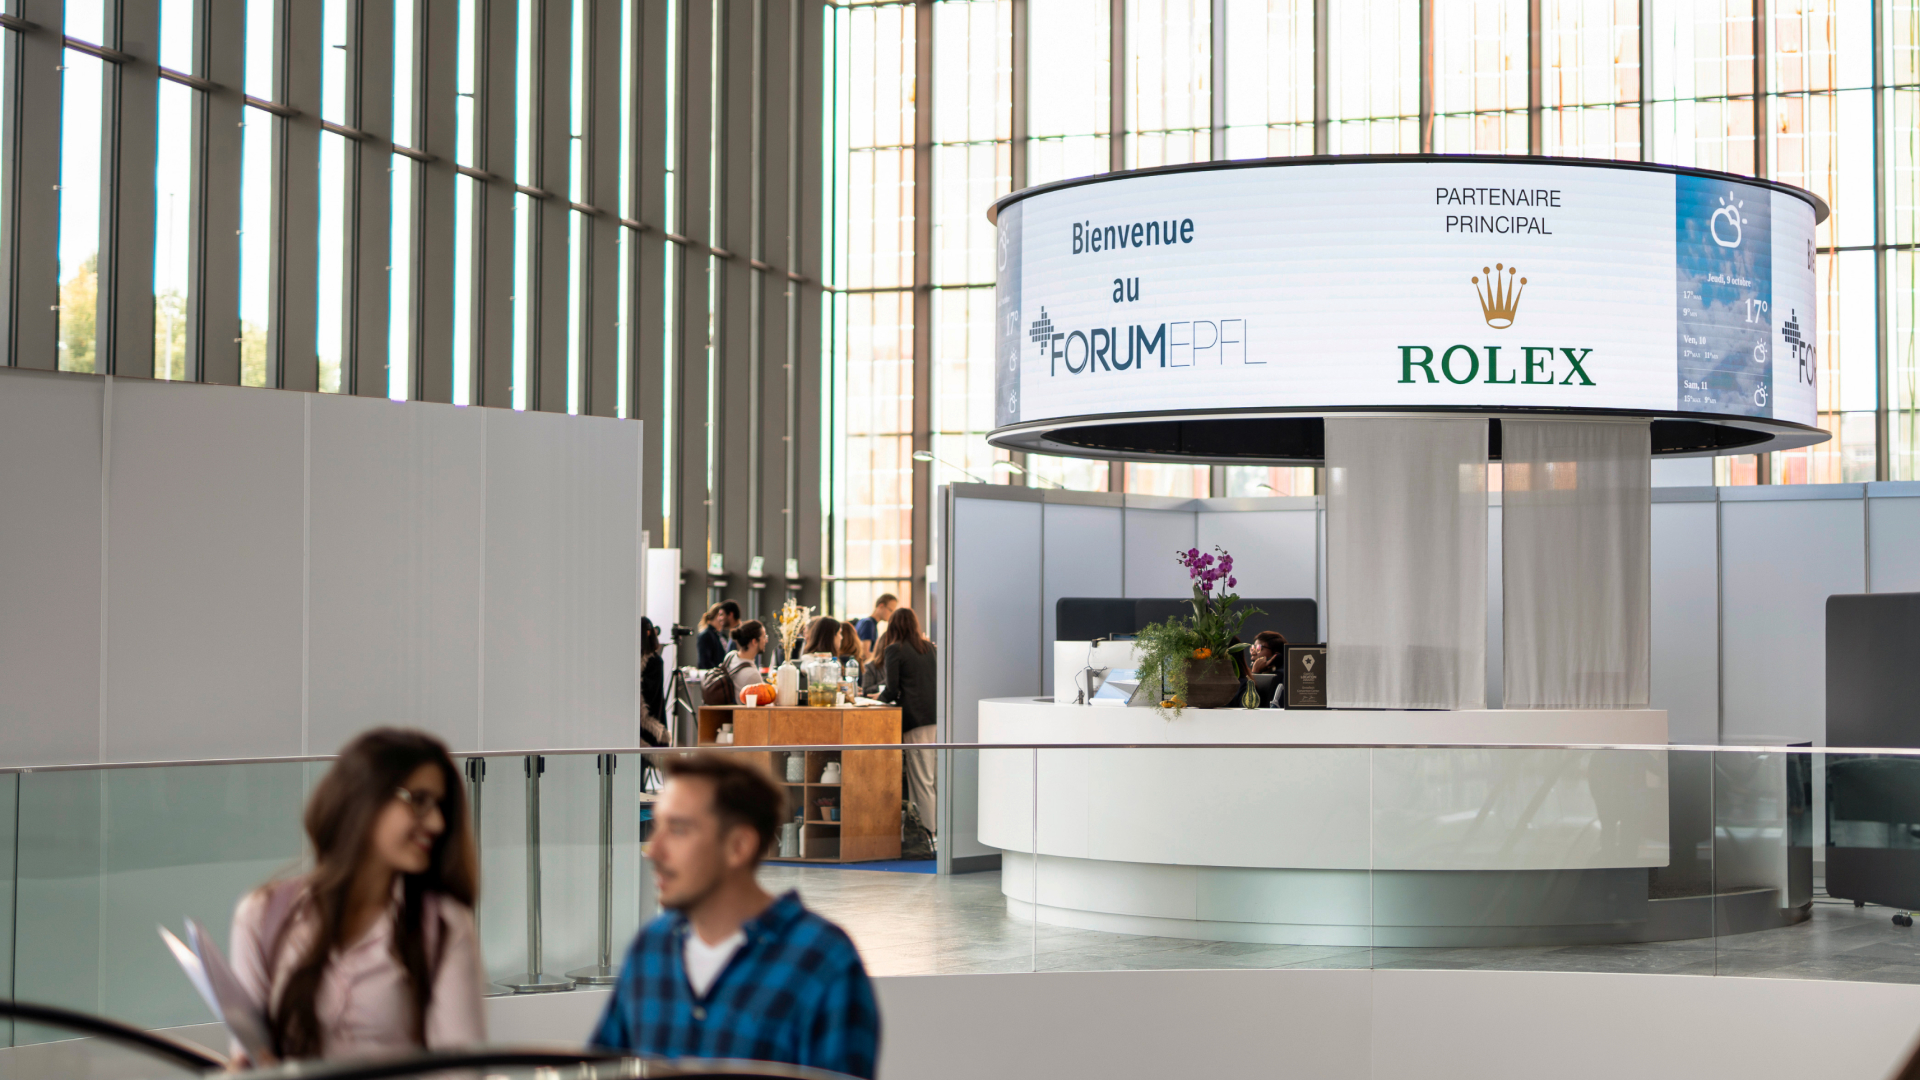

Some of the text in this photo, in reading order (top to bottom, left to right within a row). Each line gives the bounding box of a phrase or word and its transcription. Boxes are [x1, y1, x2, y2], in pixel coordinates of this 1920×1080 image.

[1436, 187, 1561, 207] PARTENAIRE
[1446, 215, 1552, 235] PRINCIPAL
[1072, 218, 1194, 255] Bienvenue
[1112, 277, 1140, 303] au
[1707, 273, 1752, 287] Jeudi, 9 octobre
[1744, 298, 1768, 324] 17°
[1683, 334, 1707, 345] Ven, 10
[1397, 344, 1597, 386] ROLEX
[1683, 380, 1708, 390] Sam, 11
